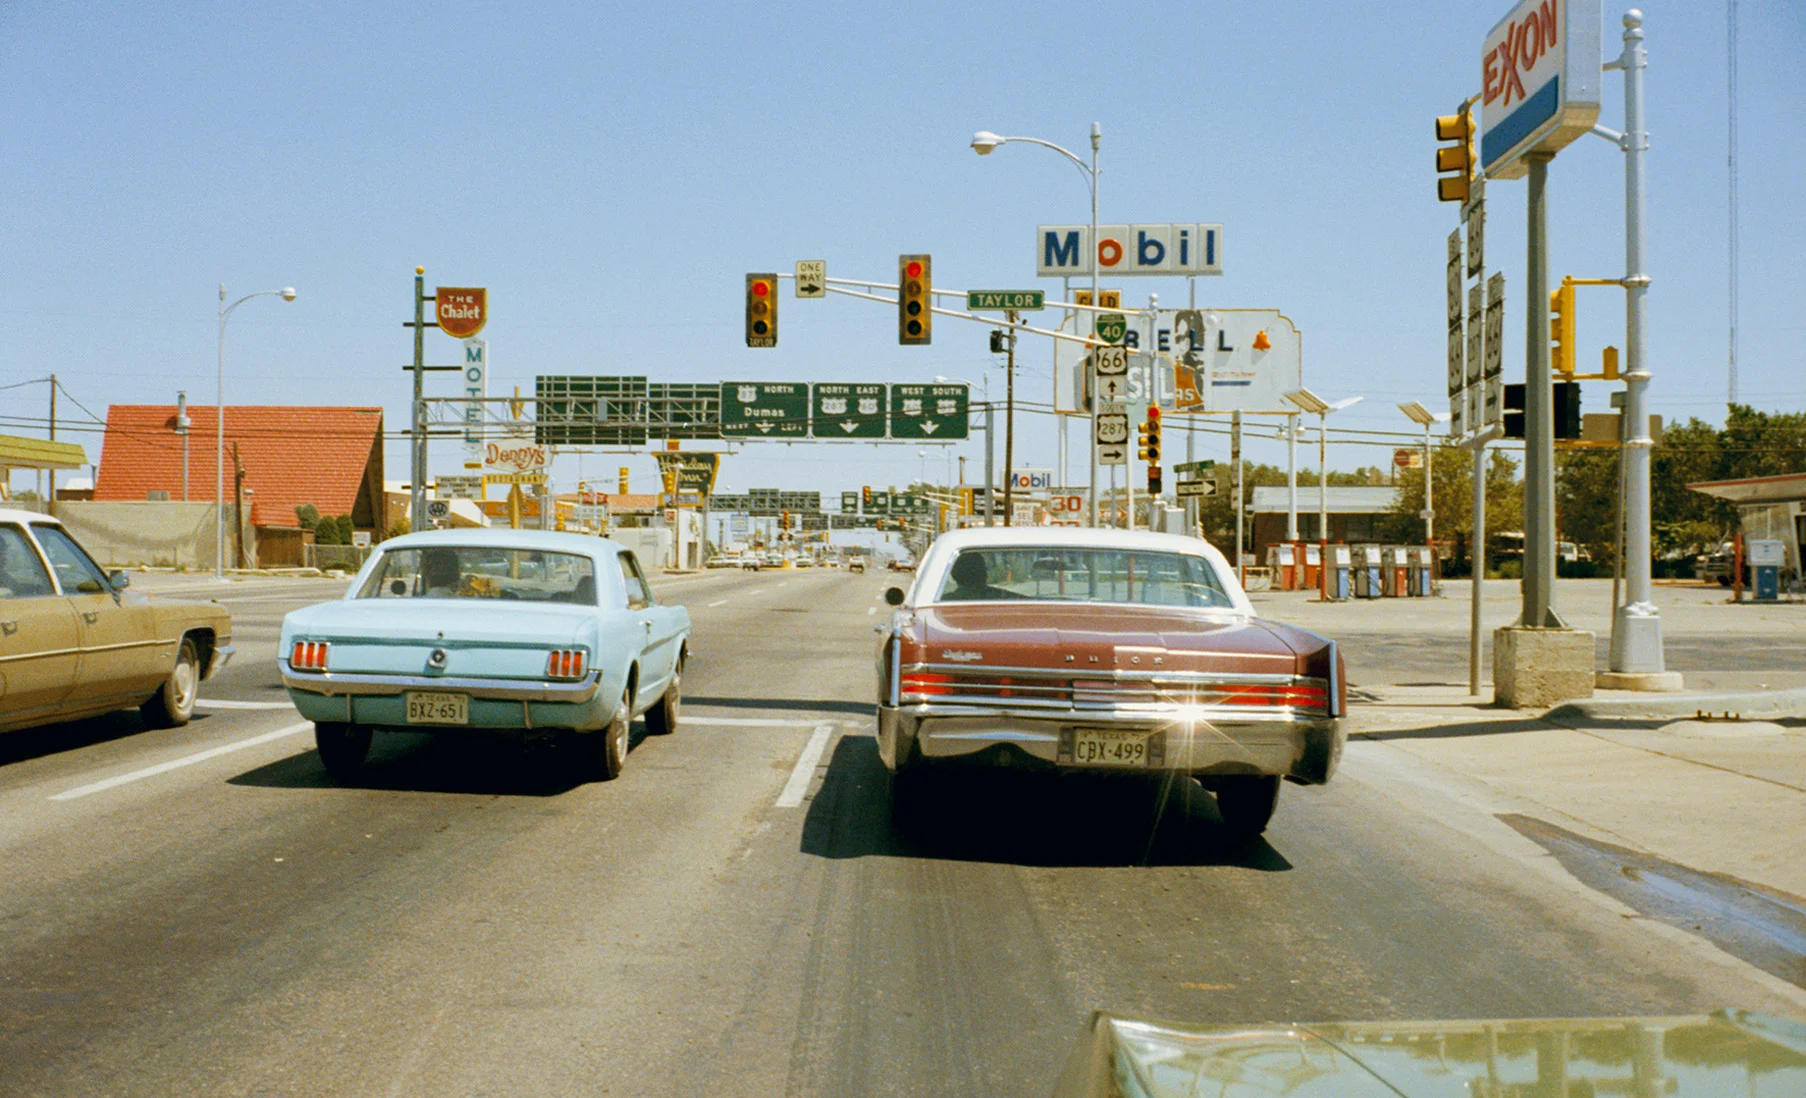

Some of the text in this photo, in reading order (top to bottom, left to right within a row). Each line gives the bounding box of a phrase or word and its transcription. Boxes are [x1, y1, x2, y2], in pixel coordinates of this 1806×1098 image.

[1484, 0, 1557, 106] EXXON
[1044, 230, 1215, 266] Mobil
[801, 263, 820, 272] ONE
[800, 273, 821, 282] WAY
[448, 295, 473, 303] THE
[977, 294, 1035, 307] TAYLOR
[440, 304, 479, 319] Chalet
[1102, 326, 1121, 339] 40
[1101, 352, 1122, 369] 66
[465, 347, 482, 443] MOTEL
[820, 386, 879, 394] NORTH EAST
[900, 387, 962, 395] WEST SOUTH
[744, 407, 785, 417] Dumas
[1101, 424, 1123, 435] 287
[485, 443, 545, 470] Denny's
[1010, 473, 1051, 488] Mobil
[410, 702, 463, 719] BXZ-651
[1077, 740, 1143, 761] CBX-499
